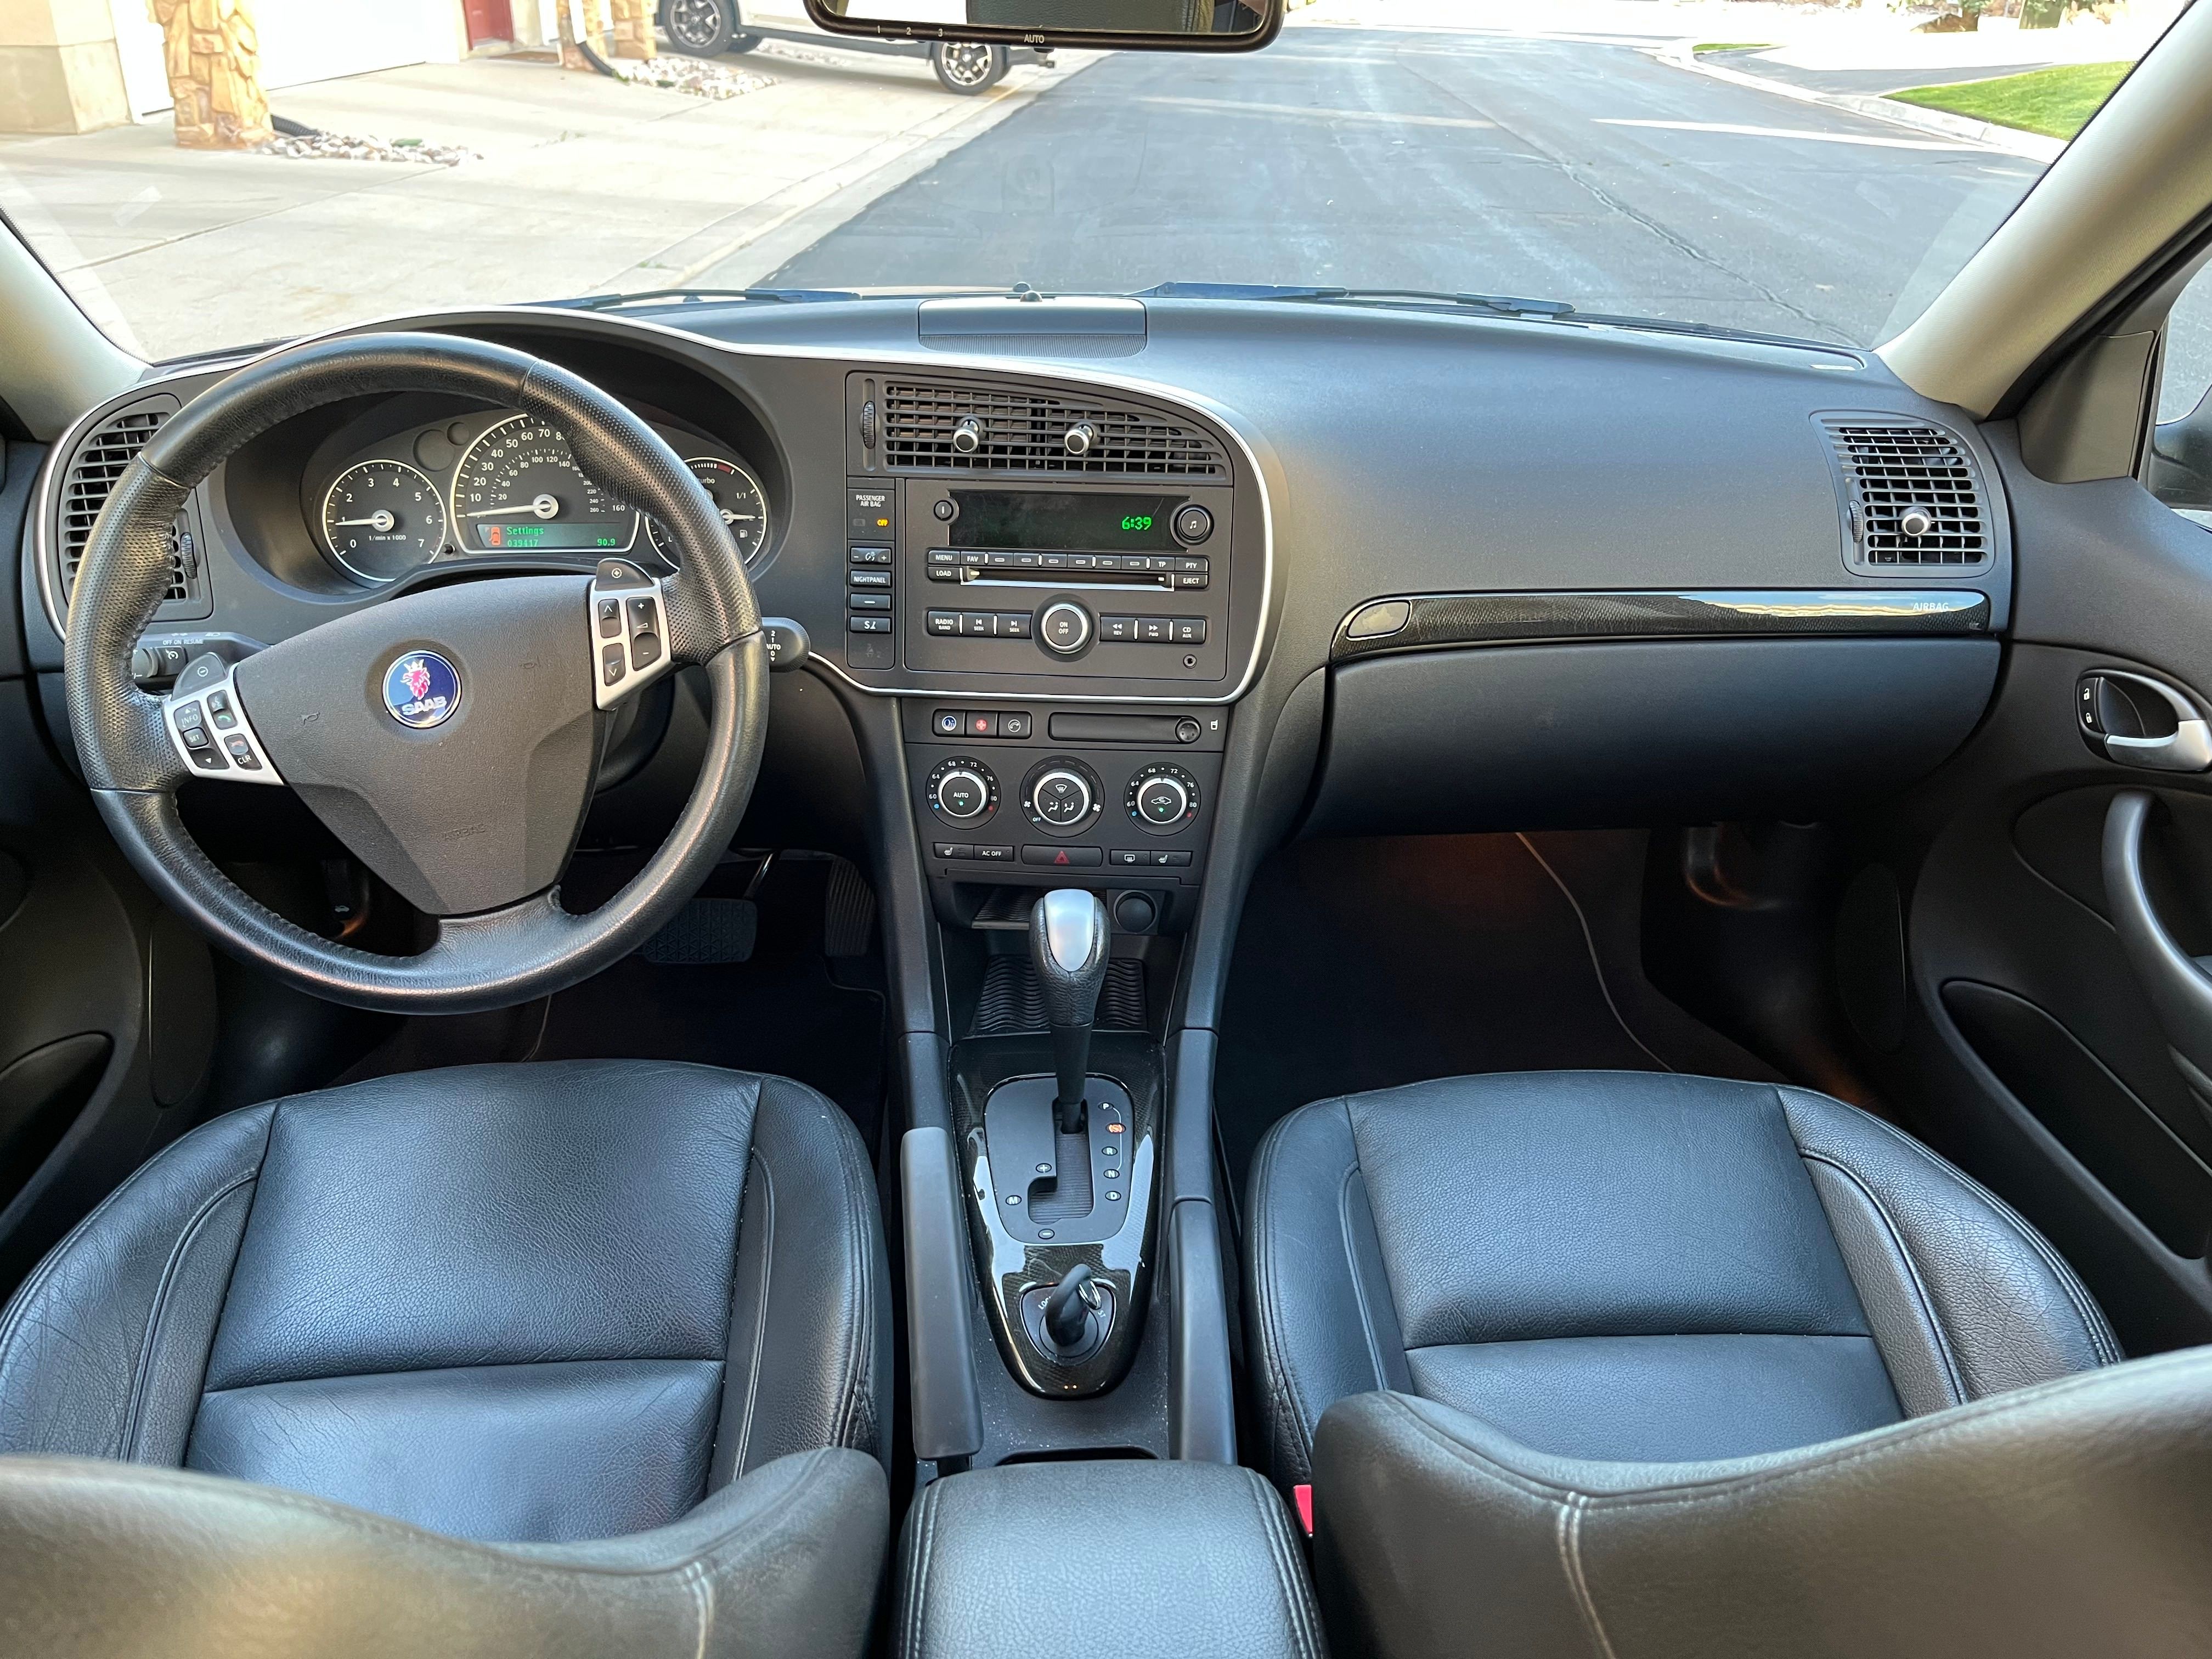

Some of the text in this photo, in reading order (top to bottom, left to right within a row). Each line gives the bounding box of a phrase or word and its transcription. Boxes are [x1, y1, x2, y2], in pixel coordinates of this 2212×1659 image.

[906, 27, 911, 35] 2
[938, 29, 943, 37] 3
[1024, 34, 1045, 44] AUTO
[521, 432, 533, 441] 60
[538, 429, 550, 437] 70
[506, 439, 518, 448] 50
[491, 449, 504, 458] 40
[481, 462, 494, 471] 30
[368, 478, 374, 487] 3
[393, 478, 399, 487] 4
[473, 477, 487, 486] 20
[346, 493, 353, 502] 2
[415, 492, 421, 501] 5
[470, 493, 481, 502] 10
[426, 516, 432, 524] 6
[1122, 516, 1152, 530] 6:39
[506, 526, 544, 536] Settings
[350, 539, 357, 548] 0
[418, 539, 424, 548] 7
[507, 539, 538, 548] 039417
[597, 538, 616, 546] 90.9
[1912, 602, 1949, 611] AIRBAG
[402, 696, 447, 716] SAAB
[181, 714, 199, 725] INFO
[238, 755, 252, 765] CLR
[1038, 1296, 1051, 1310] LOC
